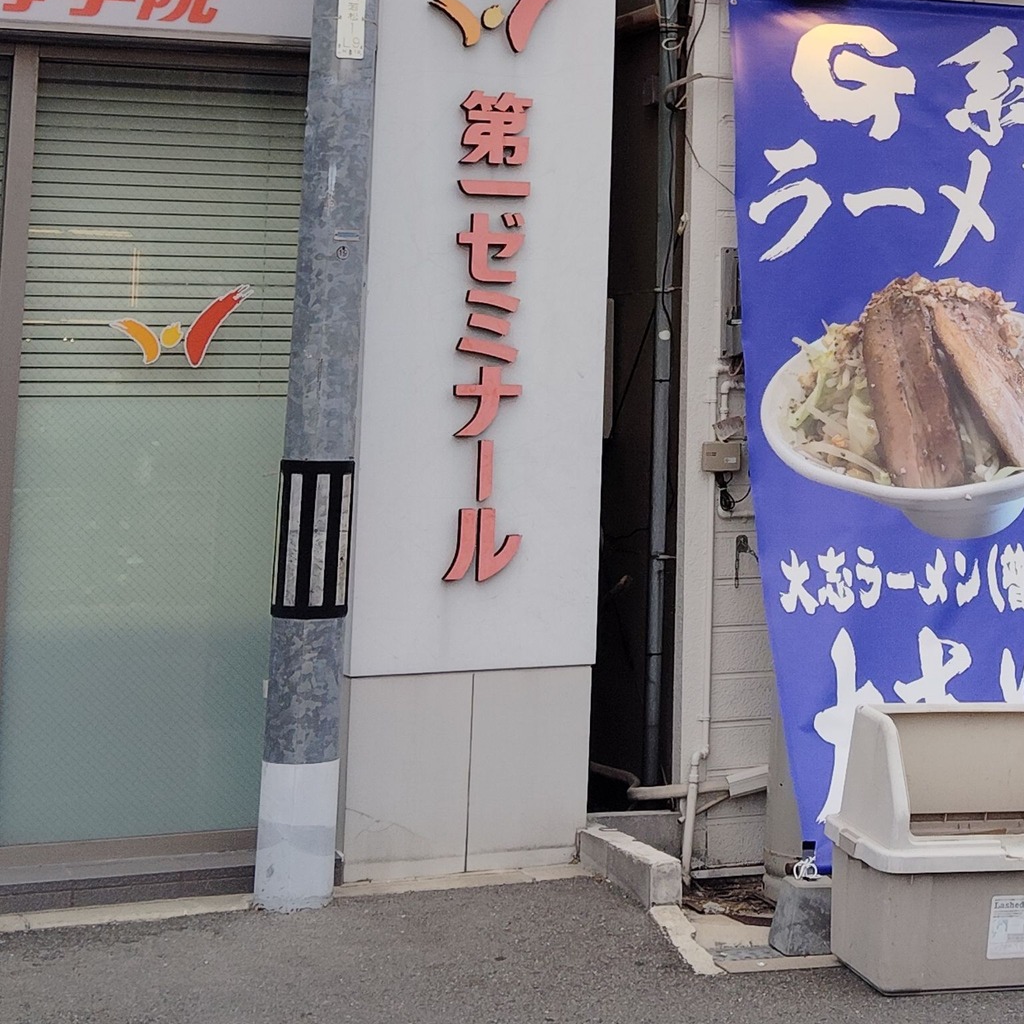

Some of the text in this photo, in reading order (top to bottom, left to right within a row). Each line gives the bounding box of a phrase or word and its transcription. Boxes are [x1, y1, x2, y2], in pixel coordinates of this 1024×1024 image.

[441, 90, 534, 582] 第一ゼミナール
